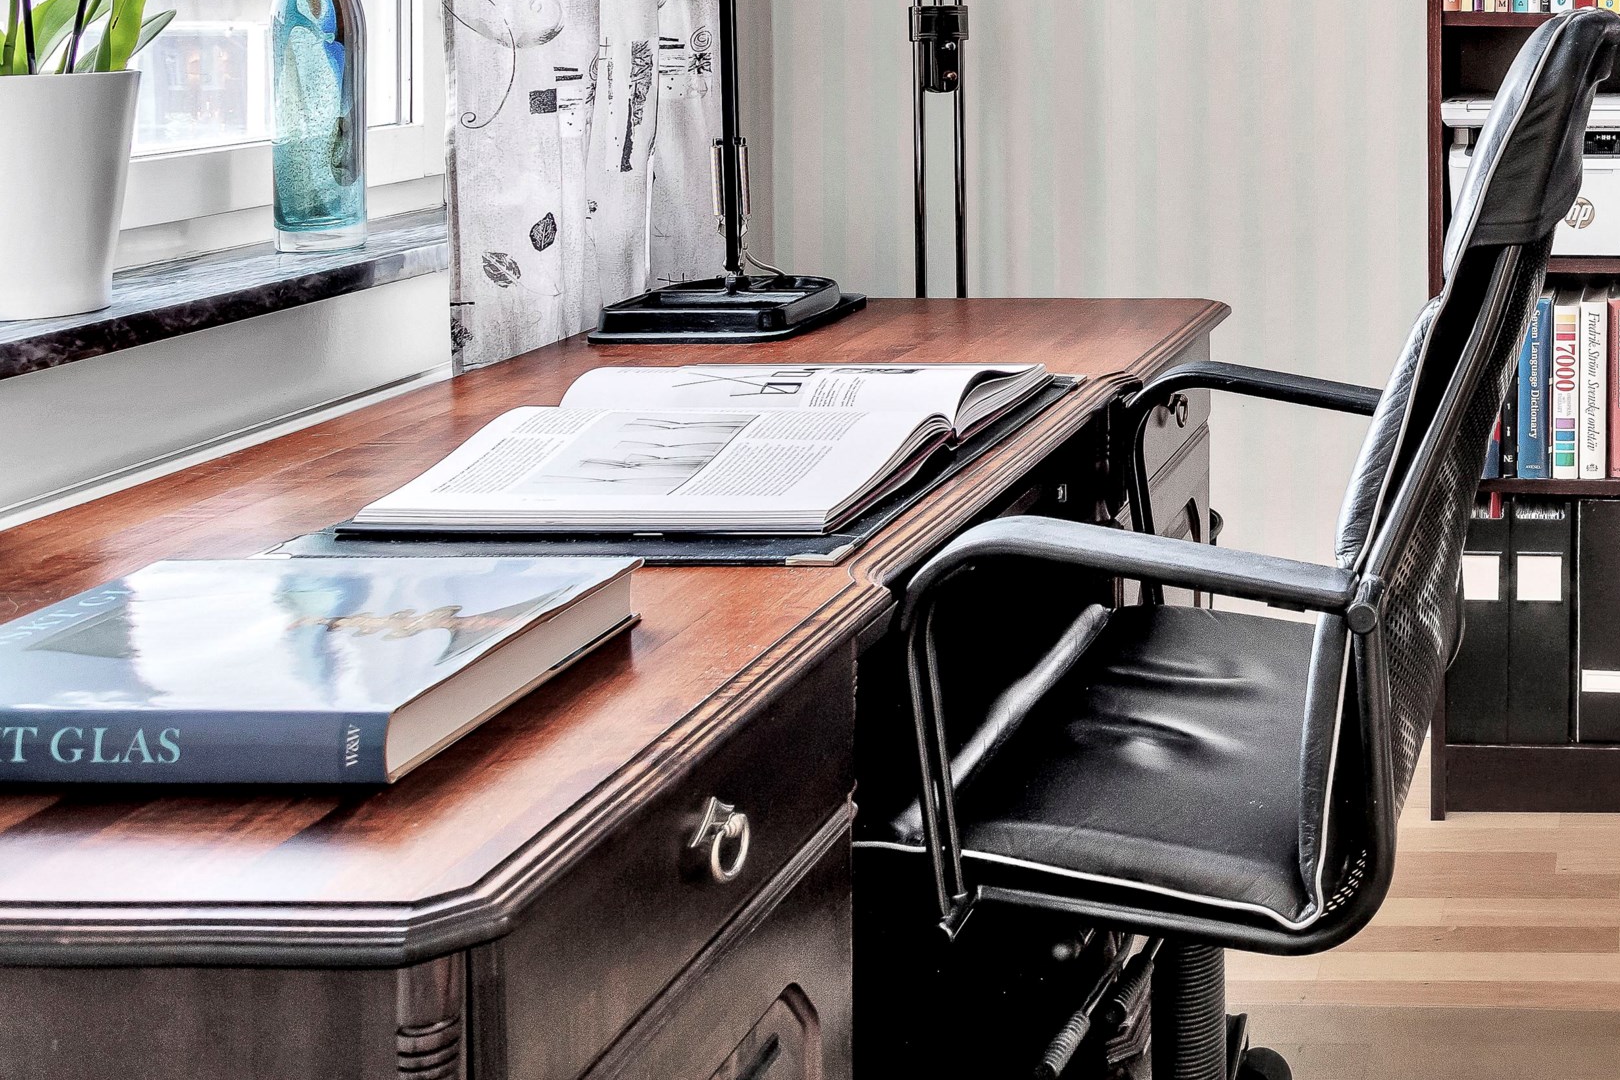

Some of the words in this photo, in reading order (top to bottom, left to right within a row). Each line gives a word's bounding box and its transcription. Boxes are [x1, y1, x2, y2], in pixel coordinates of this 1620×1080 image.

[1531, 309, 1540, 339] Seven
[1588, 312, 1600, 347] Fredrik
[1530, 342, 1540, 387] Language
[1555, 344, 1576, 392] 7000
[1587, 349, 1599, 376] Ström
[1529, 390, 1540, 438] Dictionary
[1585, 379, 1599, 417] Svenska
[1587, 418, 1599, 451] ordstäv
[50, 726, 181, 763] GLAS
